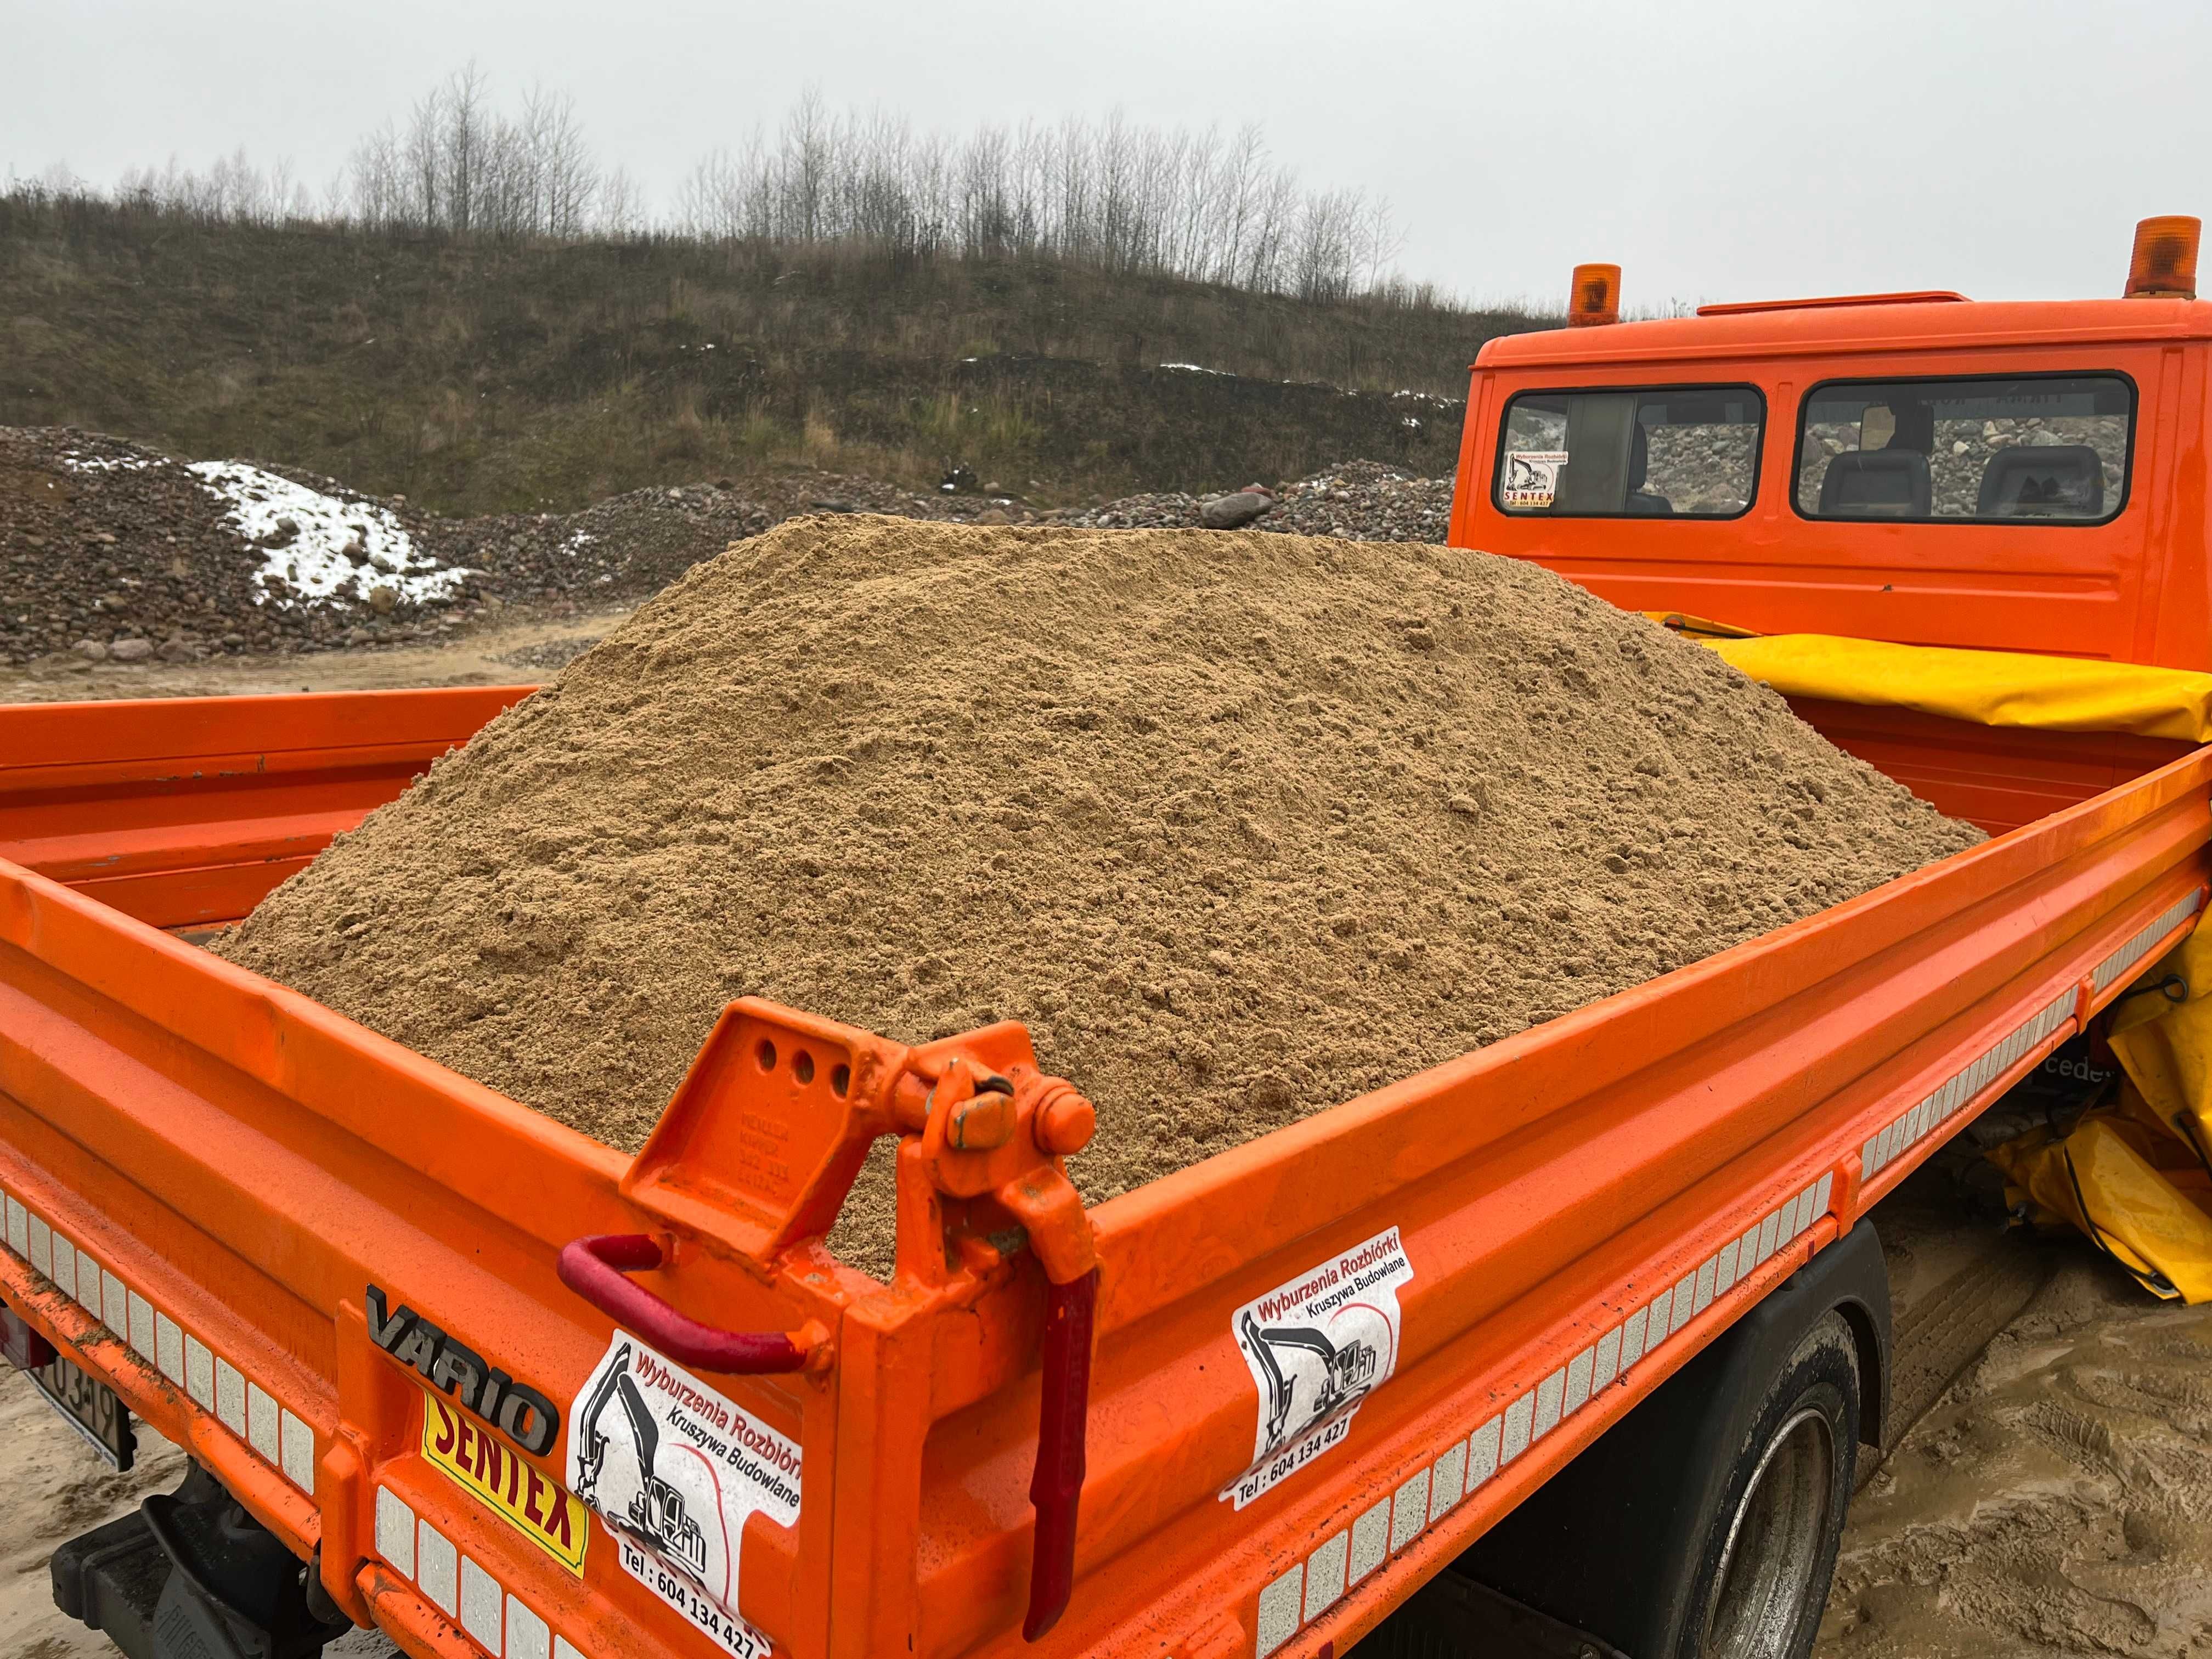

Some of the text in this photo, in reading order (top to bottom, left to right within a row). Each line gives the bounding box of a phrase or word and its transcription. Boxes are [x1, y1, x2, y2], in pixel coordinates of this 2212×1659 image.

[1504, 492, 1553, 500] SENTEX
[1257, 1232, 1399, 1322] Wyburzenia Rozbiórki
[1306, 1257, 1406, 1318] Kruszywa Budowlane
[366, 1283, 560, 1457] VARIO
[635, 1351, 730, 1431] Wyburzenia
[666, 1406, 800, 1508] Kruszywa Budowlane
[1239, 1475, 1259, 1503] Tel
[1270, 1453, 1295, 1482] 604
[1298, 1436, 1321, 1463] 134
[1324, 1418, 1347, 1444] 427
[624, 1544, 644, 1576] Tel
[658, 1573, 686, 1609] 604
[690, 1597, 720, 1634] 134
[724, 1627, 754, 1659] 427
